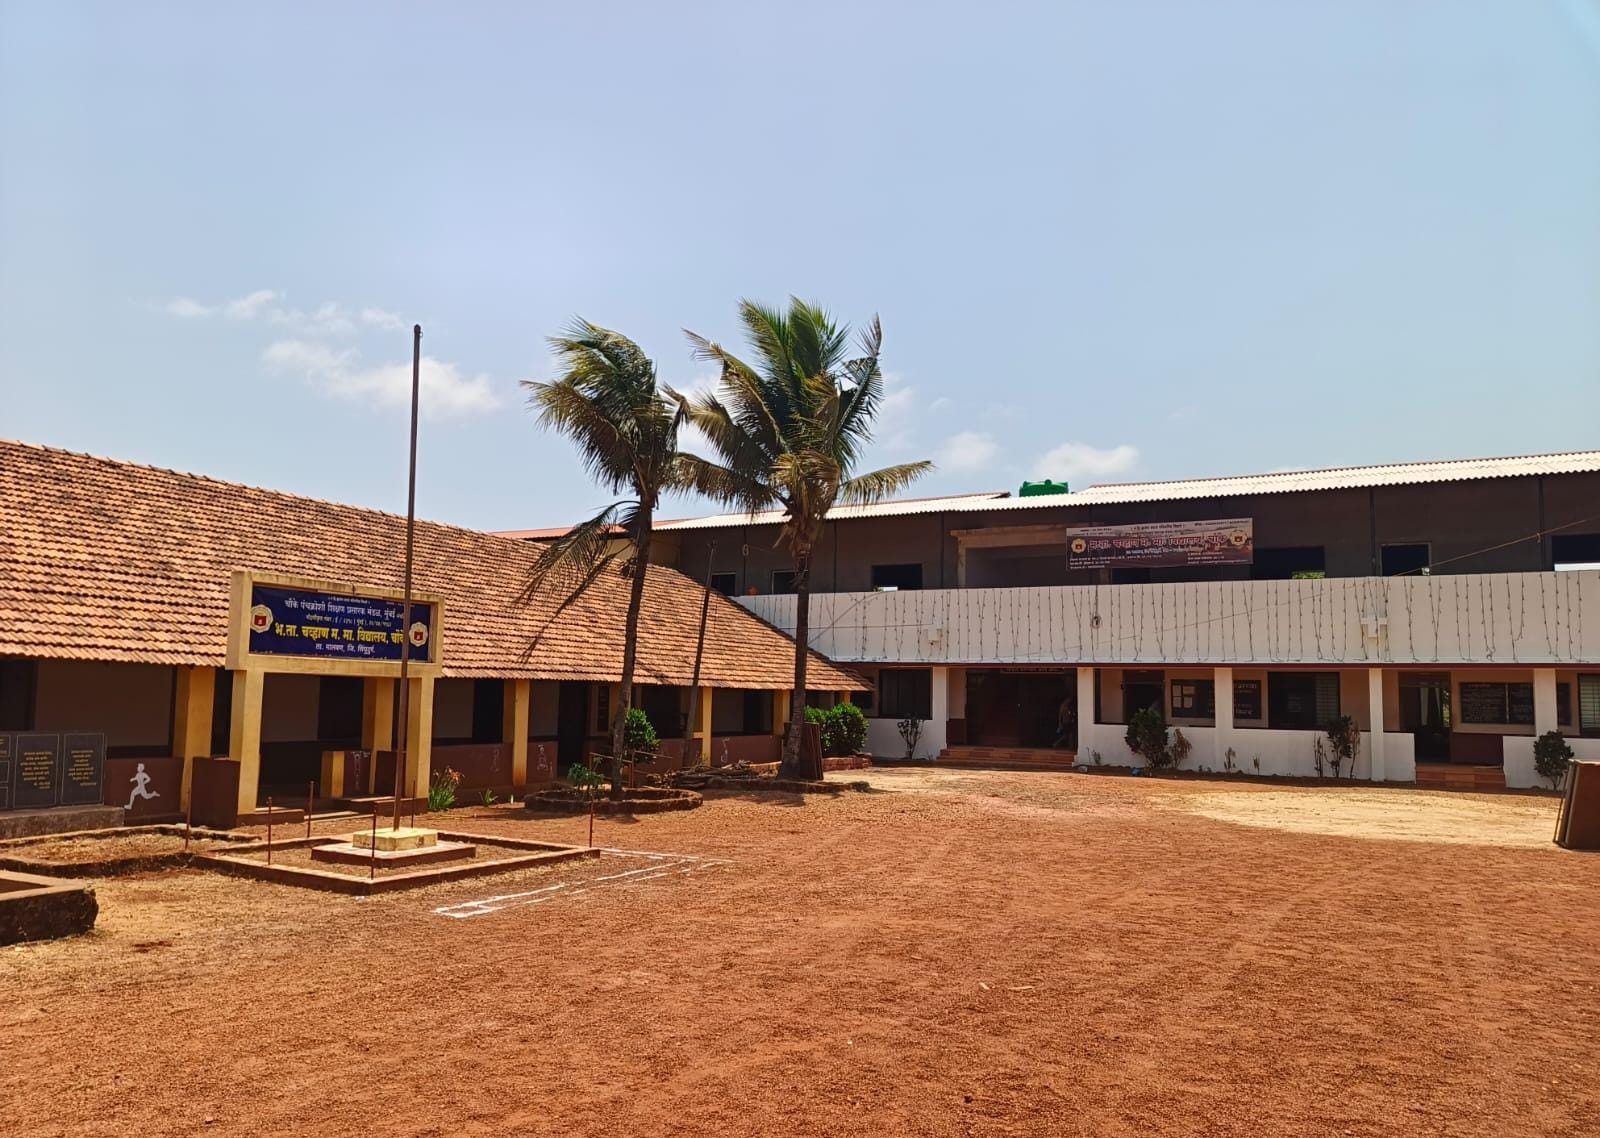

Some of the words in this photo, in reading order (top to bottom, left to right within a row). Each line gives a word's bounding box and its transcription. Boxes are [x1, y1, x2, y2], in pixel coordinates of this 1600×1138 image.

[284, 597, 299, 608] चौके
[300, 600, 326, 612] पंचक्रोशी
[327, 601, 345, 613] शिक्षण
[301, 625, 329, 641] चव्हाण
